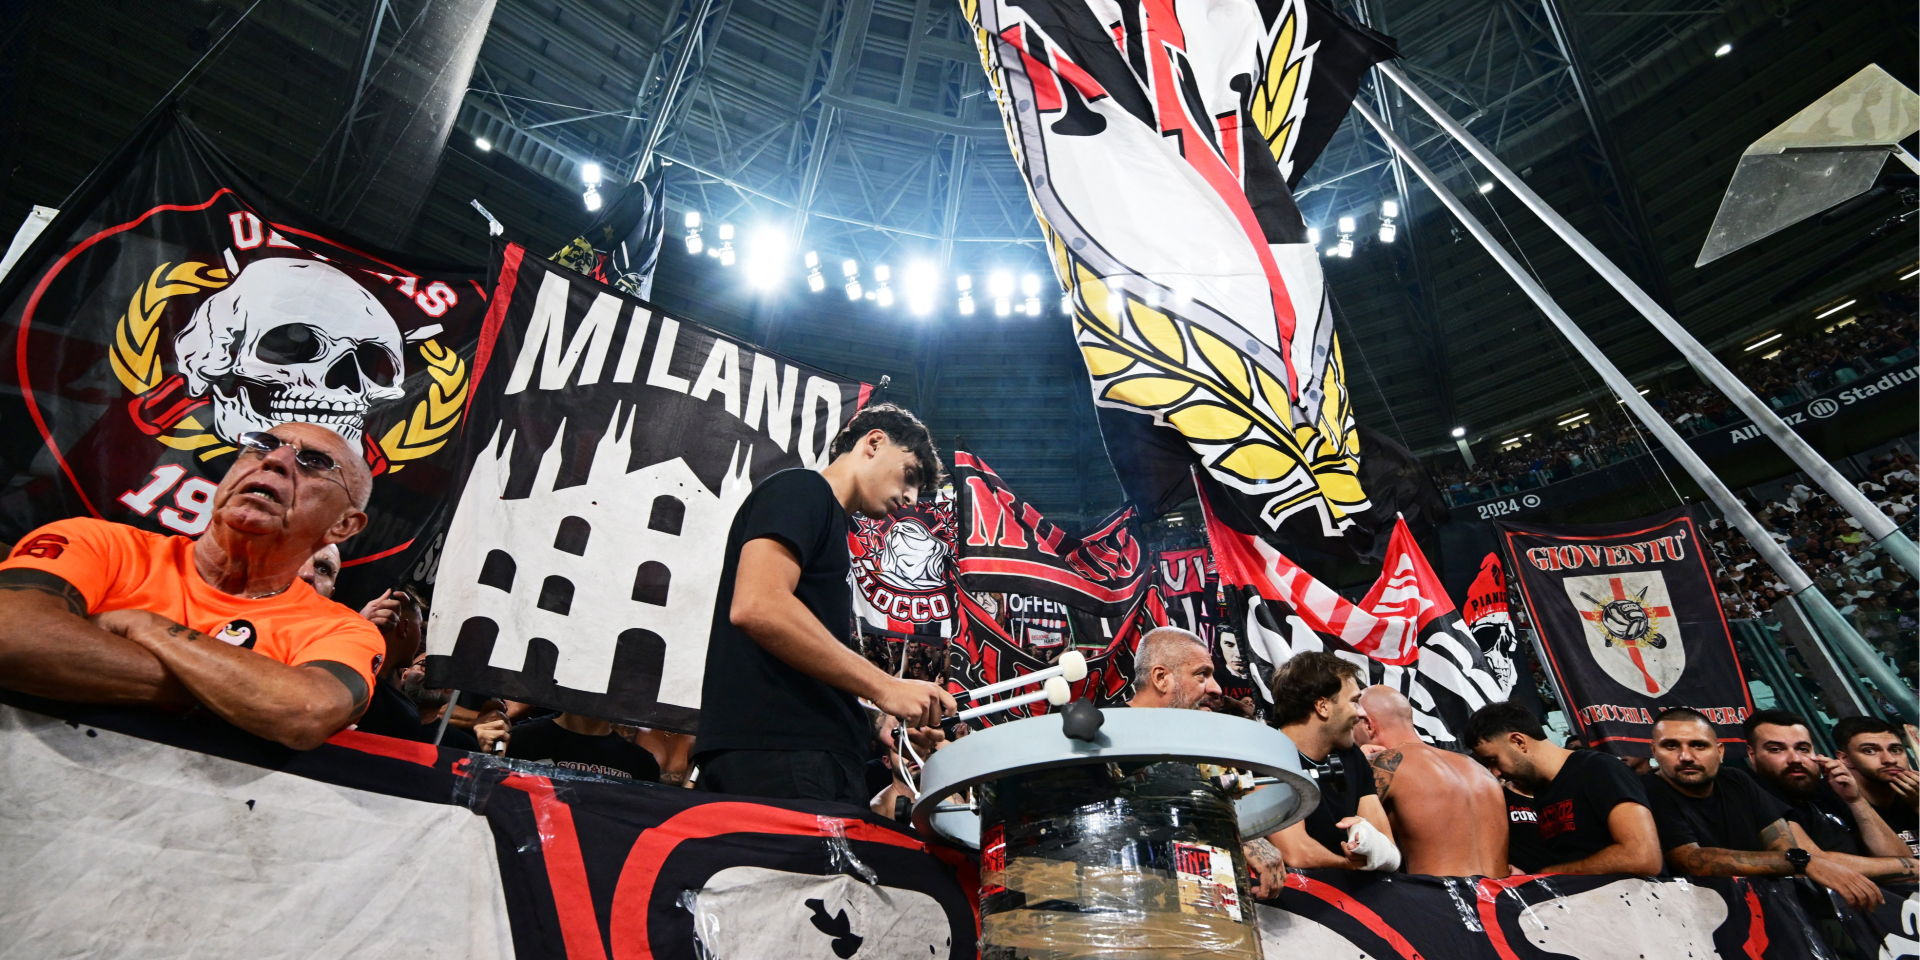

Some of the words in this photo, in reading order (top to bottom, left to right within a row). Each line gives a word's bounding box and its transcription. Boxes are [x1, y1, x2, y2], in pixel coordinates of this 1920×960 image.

[505, 270, 842, 472] MILANO
[1838, 366, 1919, 406] Stadiu
[1477, 499, 1520, 520] 2024
[13, 533, 69, 560] 6
[1579, 703, 1654, 726] VECCHIA
